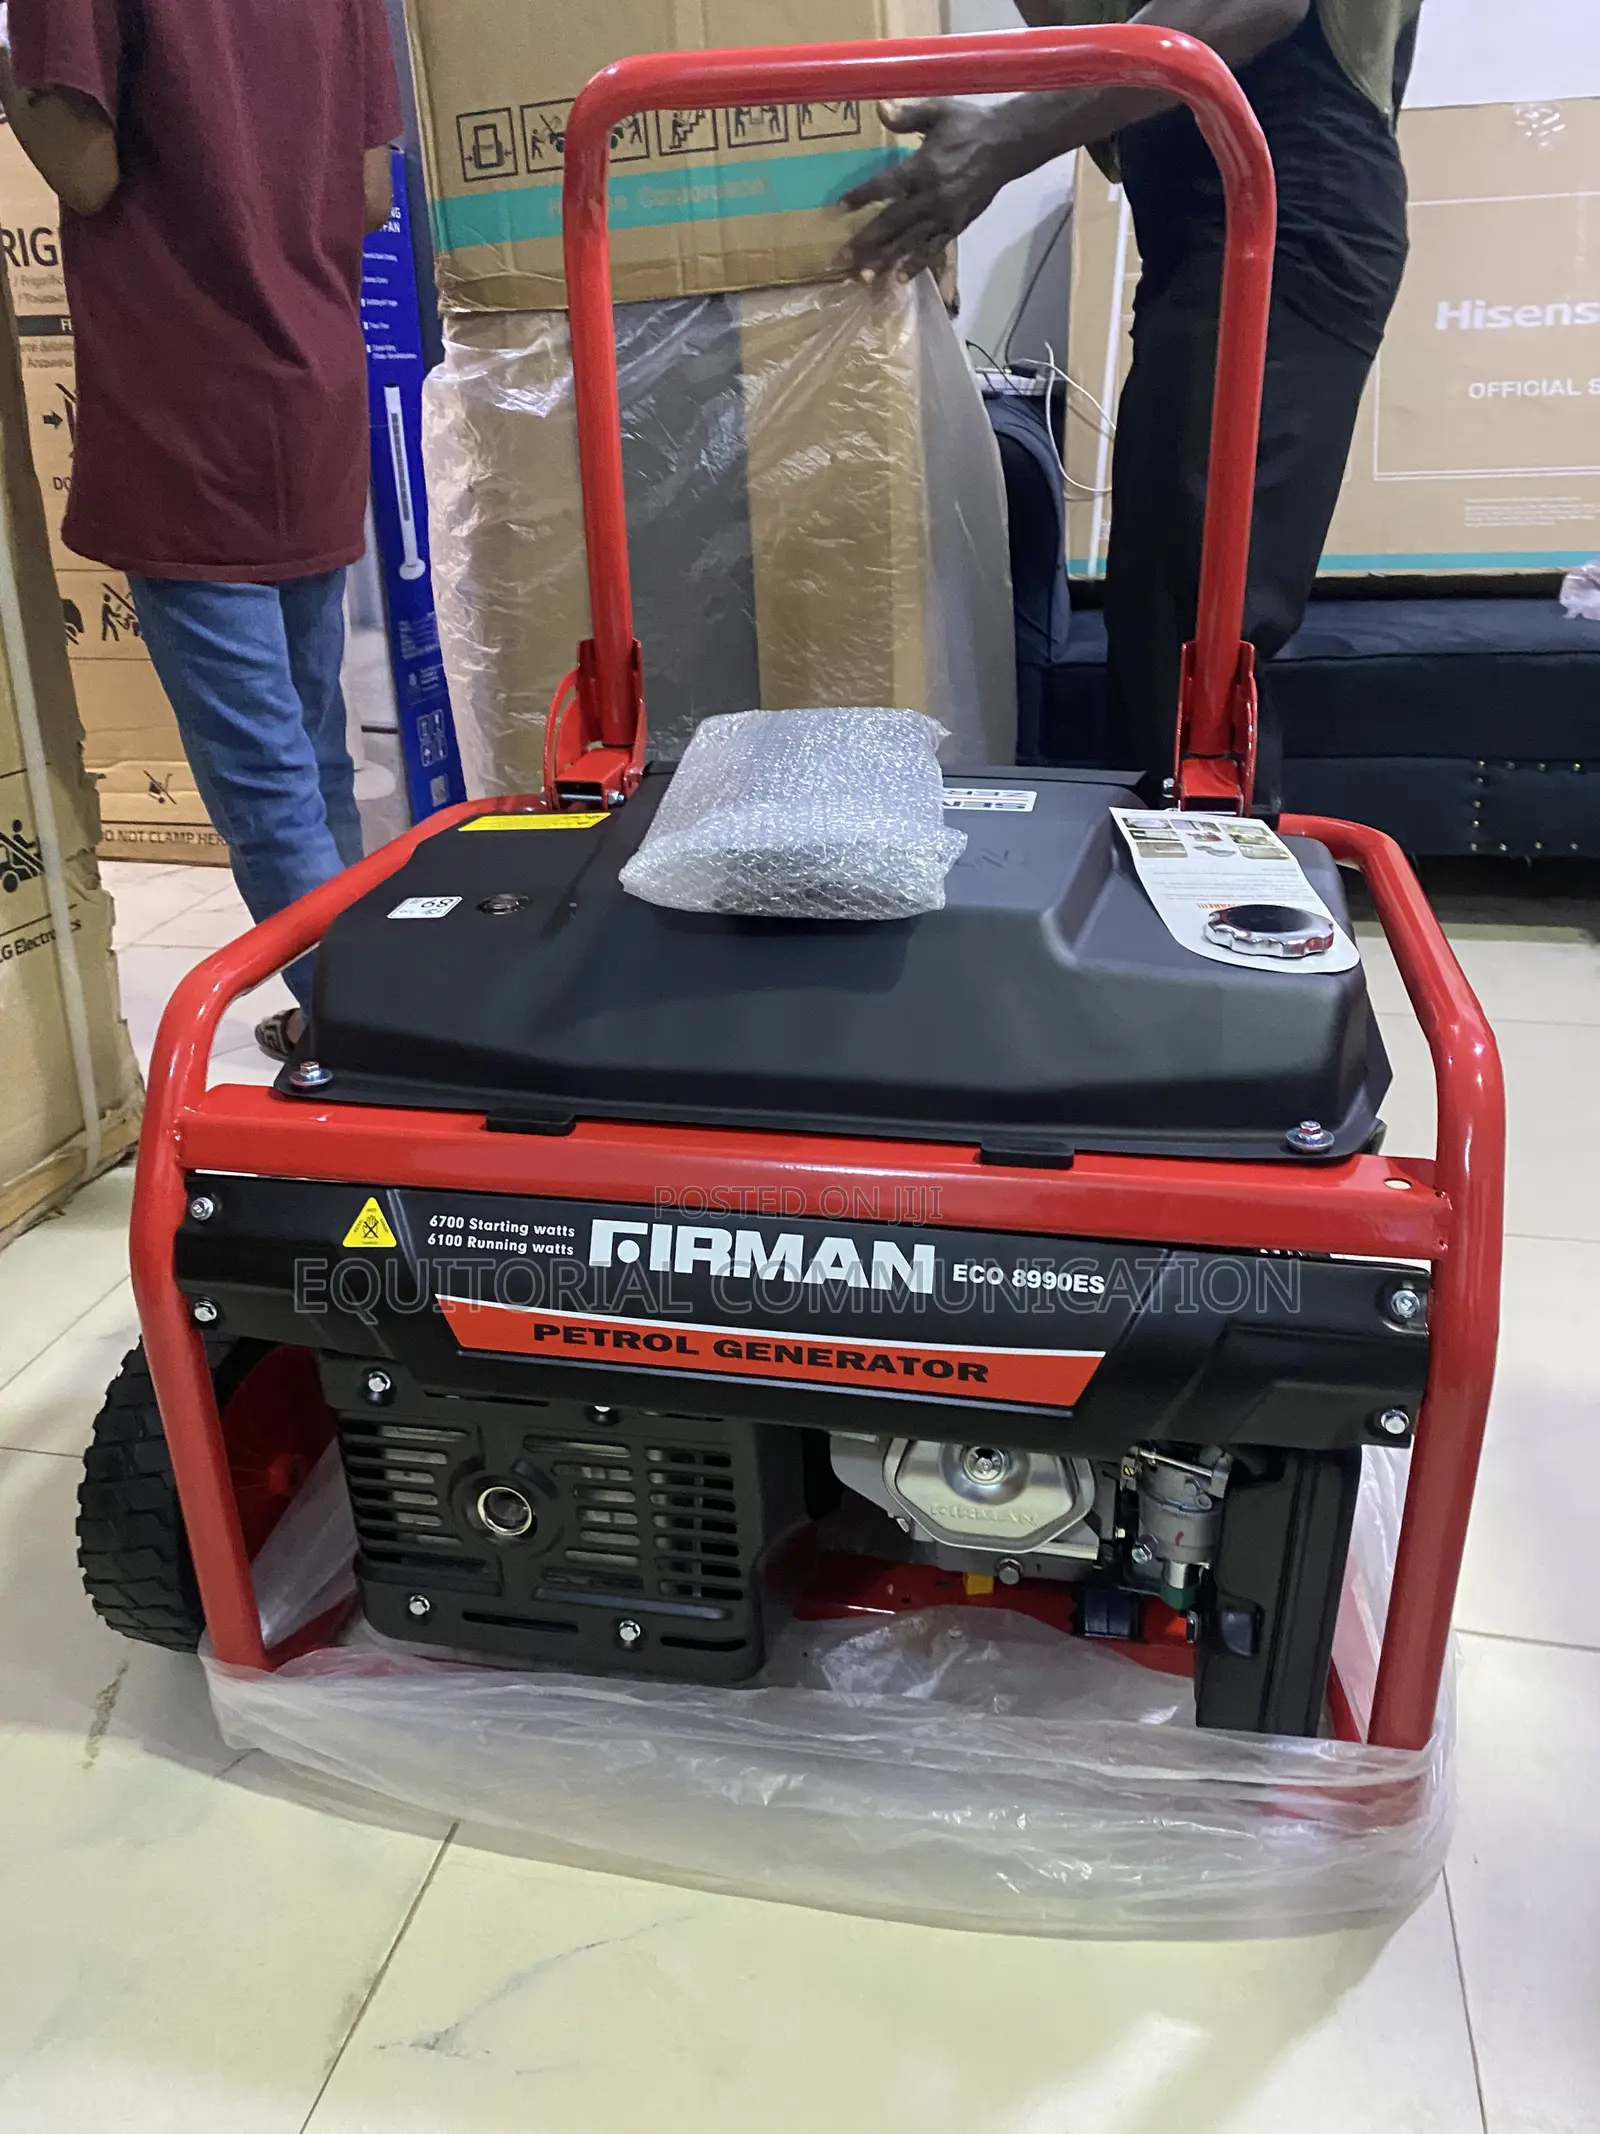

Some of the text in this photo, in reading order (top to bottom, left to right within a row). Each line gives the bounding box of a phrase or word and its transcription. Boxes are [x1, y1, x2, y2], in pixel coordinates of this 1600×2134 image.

[1435, 299, 1600, 331] Hisens
[1468, 377, 1582, 399] OFFICIAL
[118, 830, 145, 843] NOT
[149, 831, 194, 845] CLAMP
[429, 1215, 576, 1238] 6700 Starting watts
[427, 1233, 575, 1256] 6100 Running watts
[589, 1219, 936, 1295] FIRMAN
[952, 1263, 1106, 1295] ECO 8990ES
[533, 1323, 989, 1383] PETROL GENERATOR
